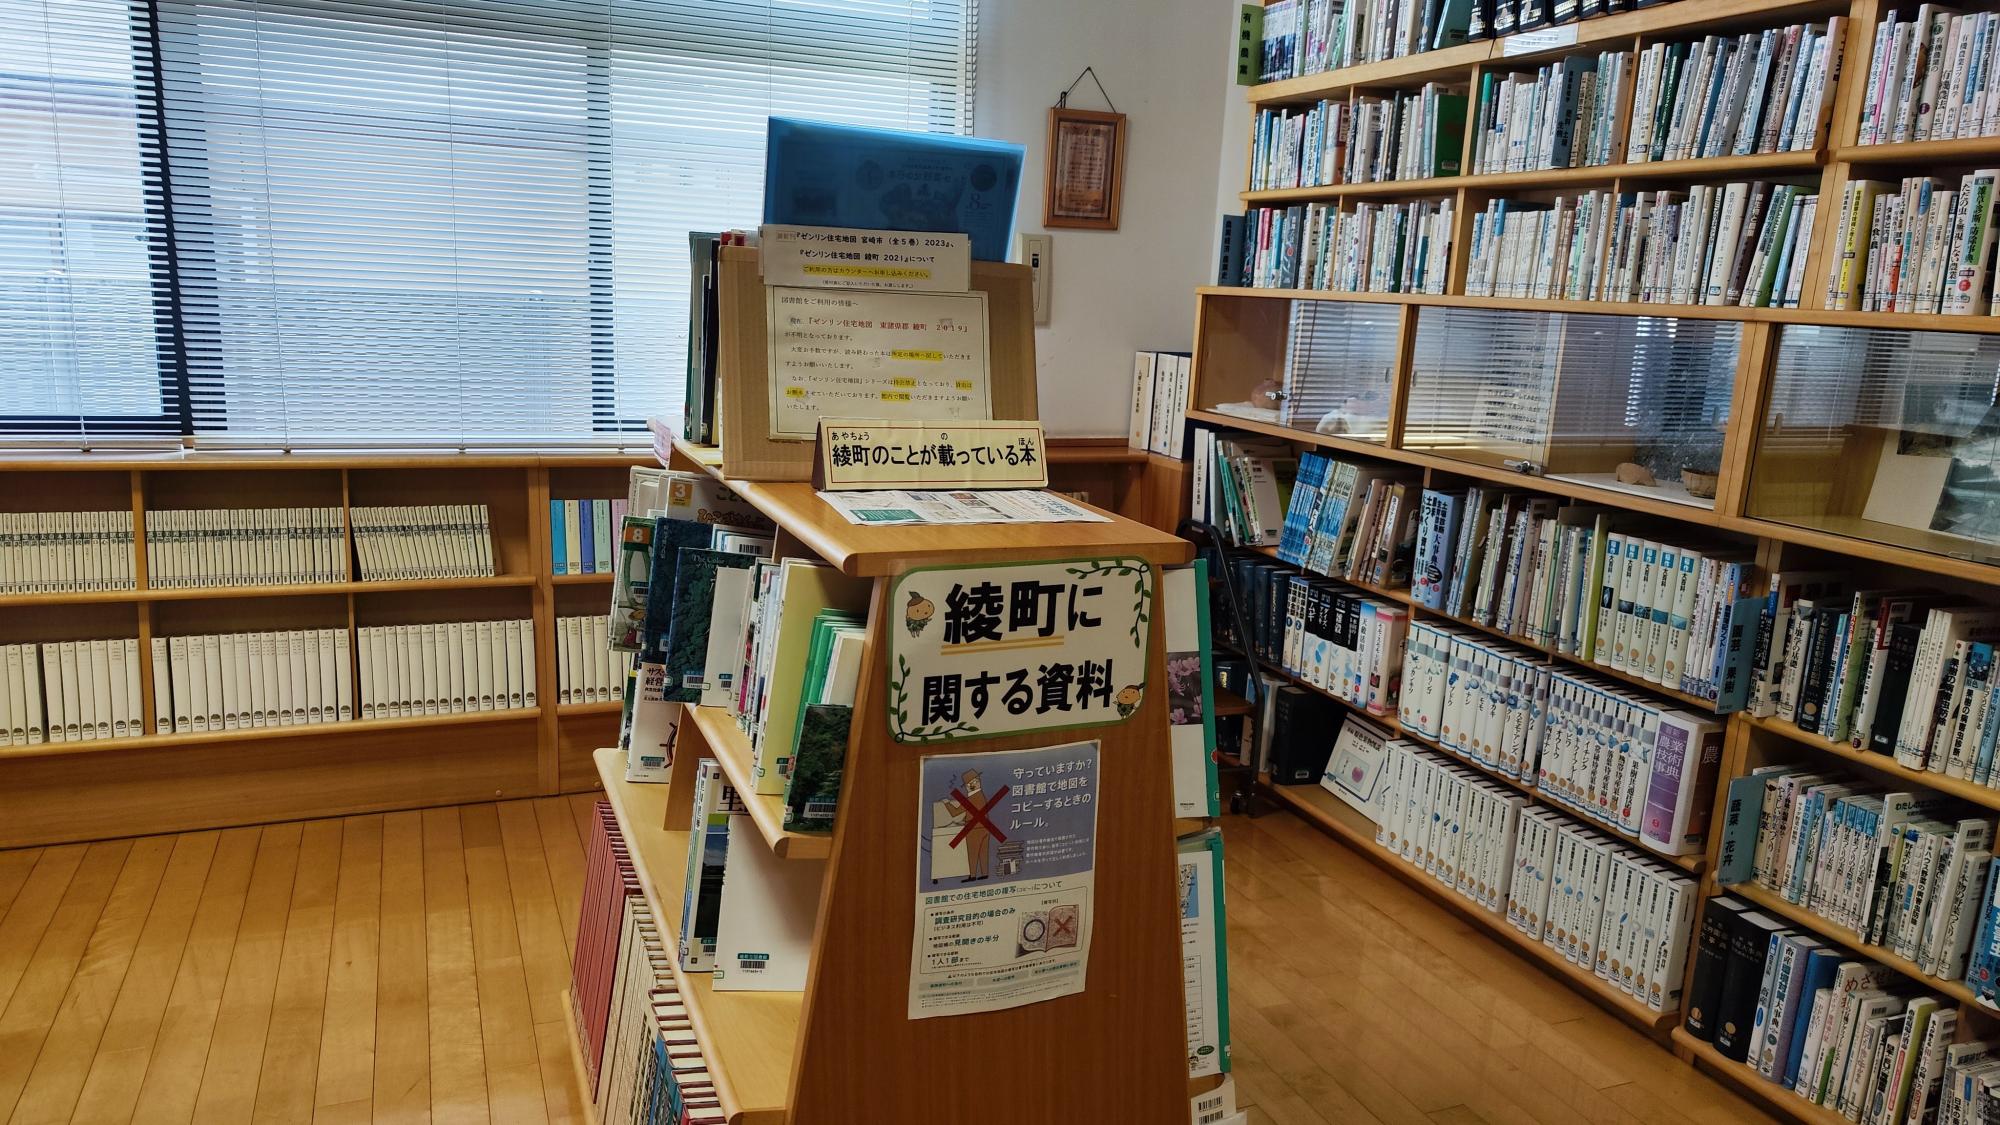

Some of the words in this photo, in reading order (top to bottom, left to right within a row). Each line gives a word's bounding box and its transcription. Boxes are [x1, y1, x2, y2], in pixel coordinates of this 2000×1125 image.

[941, 432, 949, 441] の
[1018, 438, 1035, 446] ほん
[832, 444, 1037, 468] 綾町のことが載っている本
[942, 580, 1104, 645] 綾町に
[921, 658, 1114, 726] 関する資料
[1012, 775, 1089, 797] 図書館で地図を
[1011, 793, 1092, 814] コピーするときの
